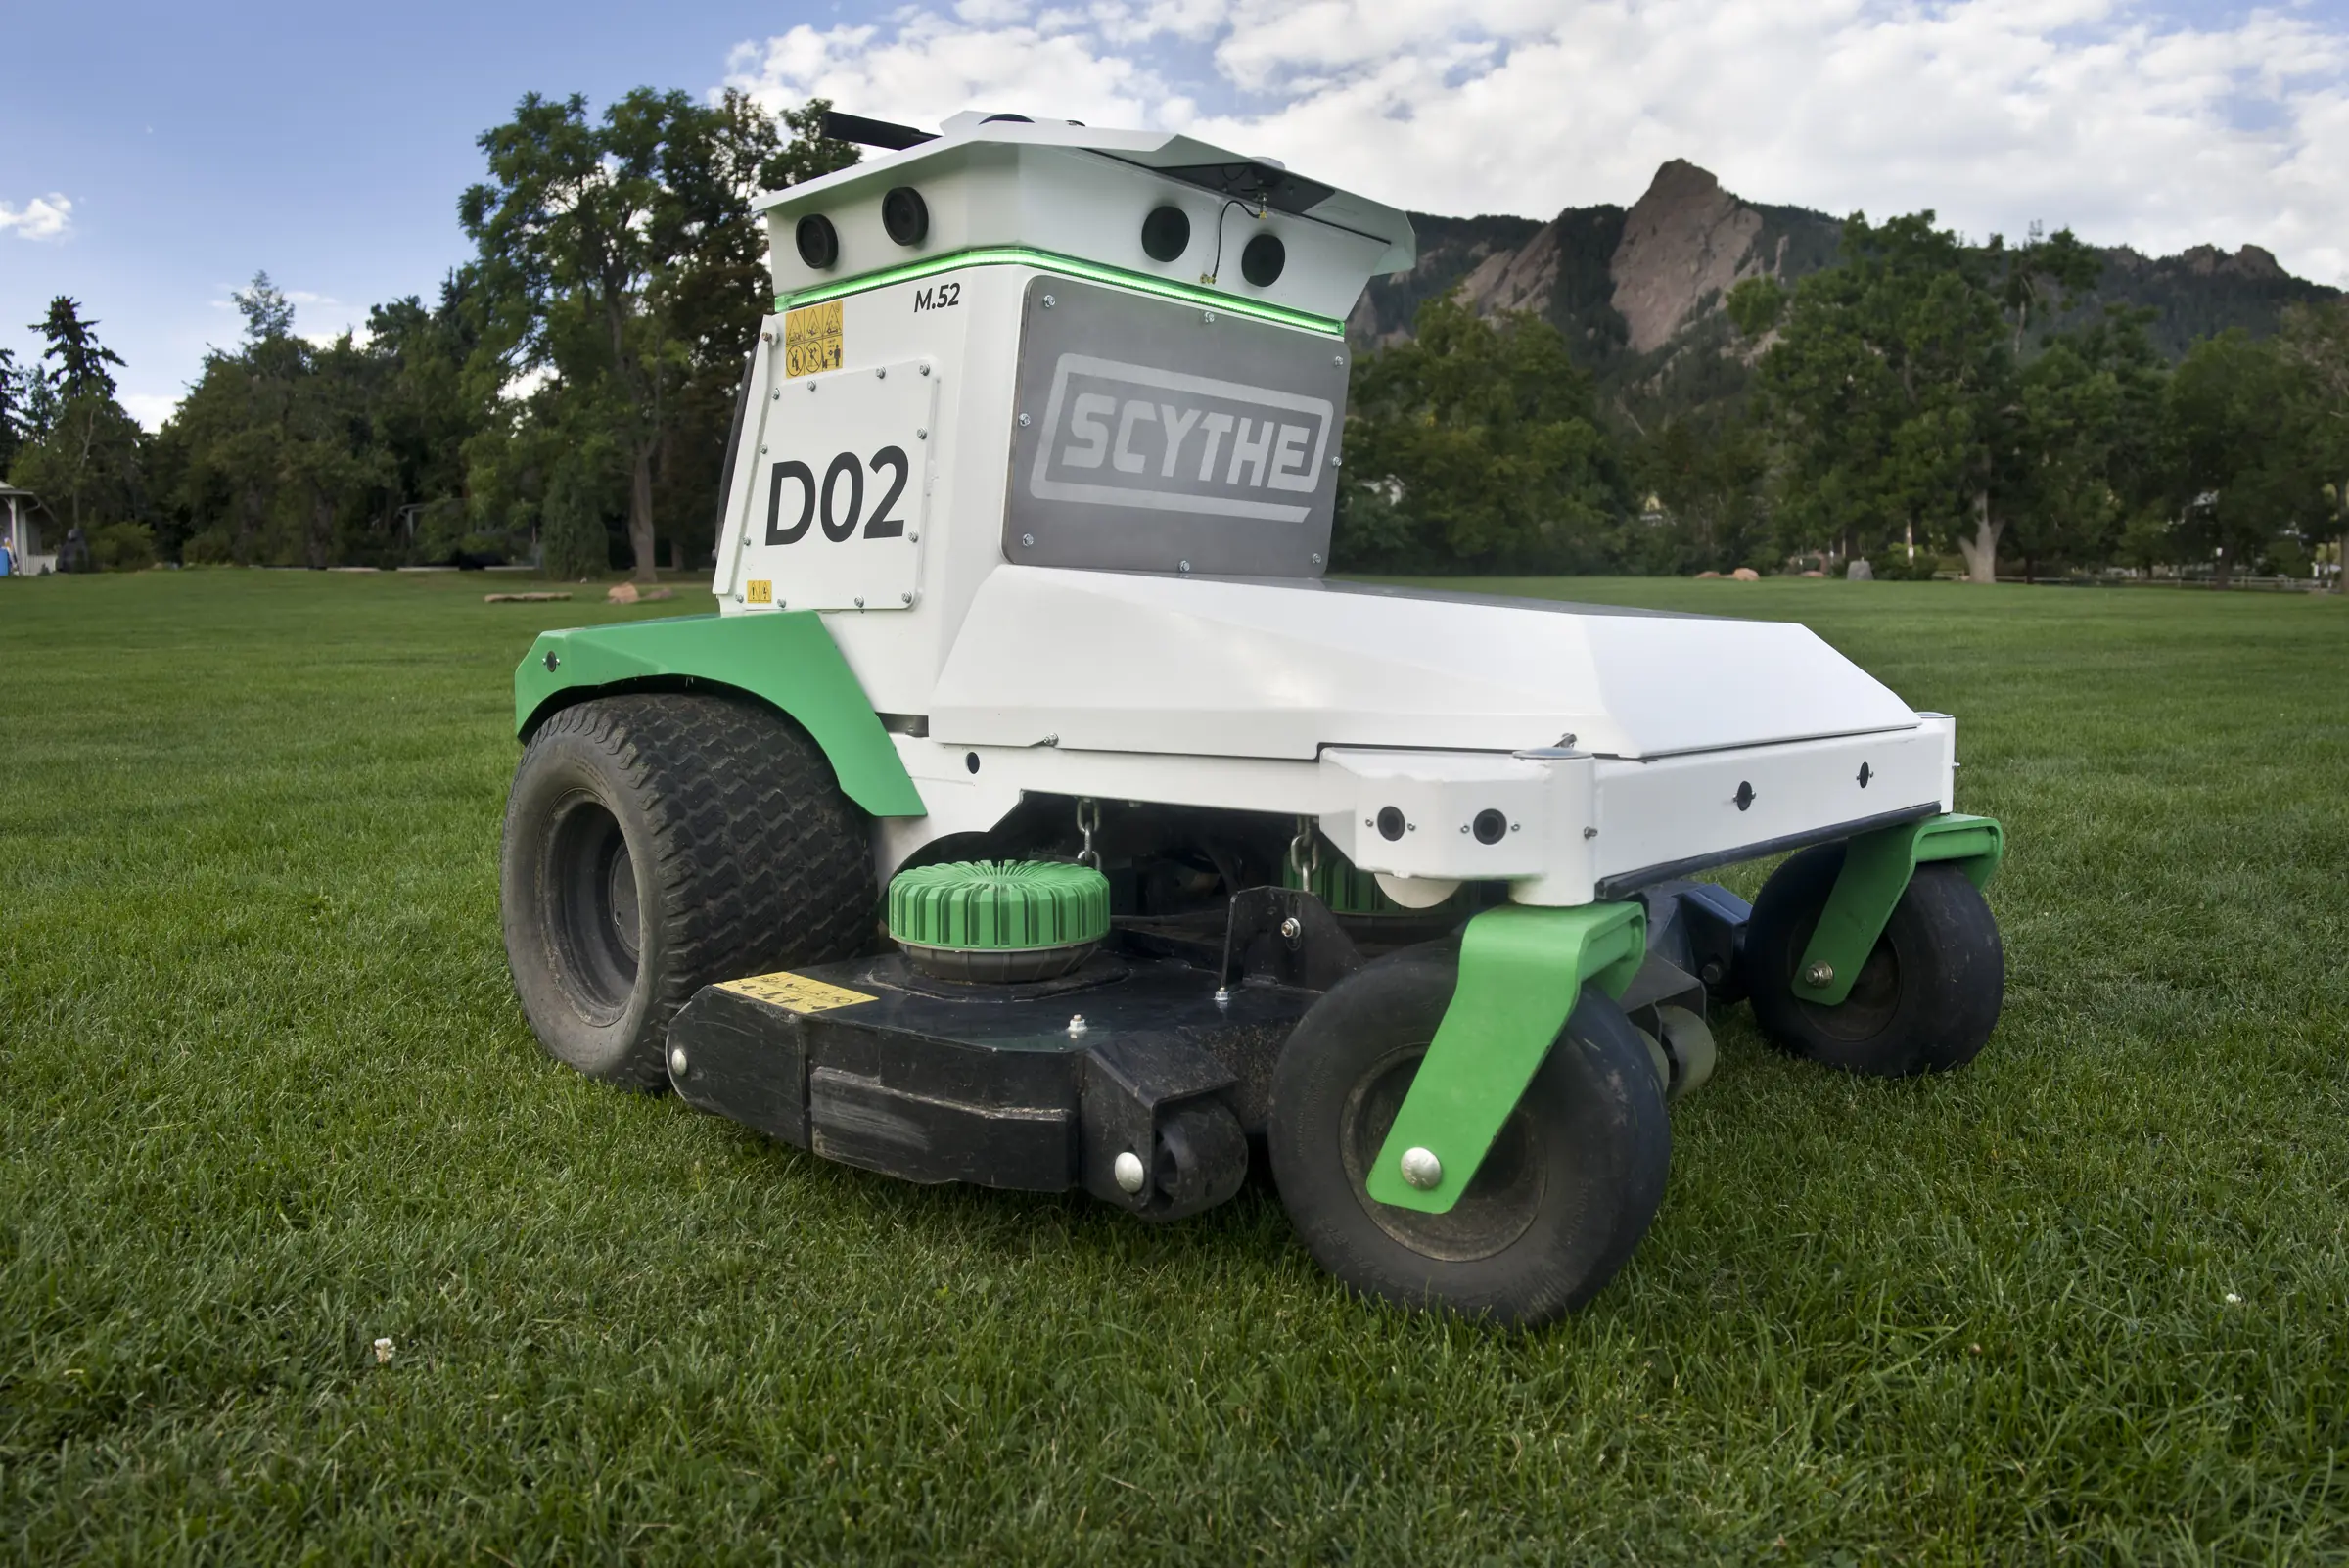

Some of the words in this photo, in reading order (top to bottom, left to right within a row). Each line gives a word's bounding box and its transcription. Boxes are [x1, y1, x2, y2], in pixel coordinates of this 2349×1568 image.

[914, 282, 961, 313] M.52
[1062, 393, 1312, 492] SCYTHE
[764, 445, 909, 546] D02
